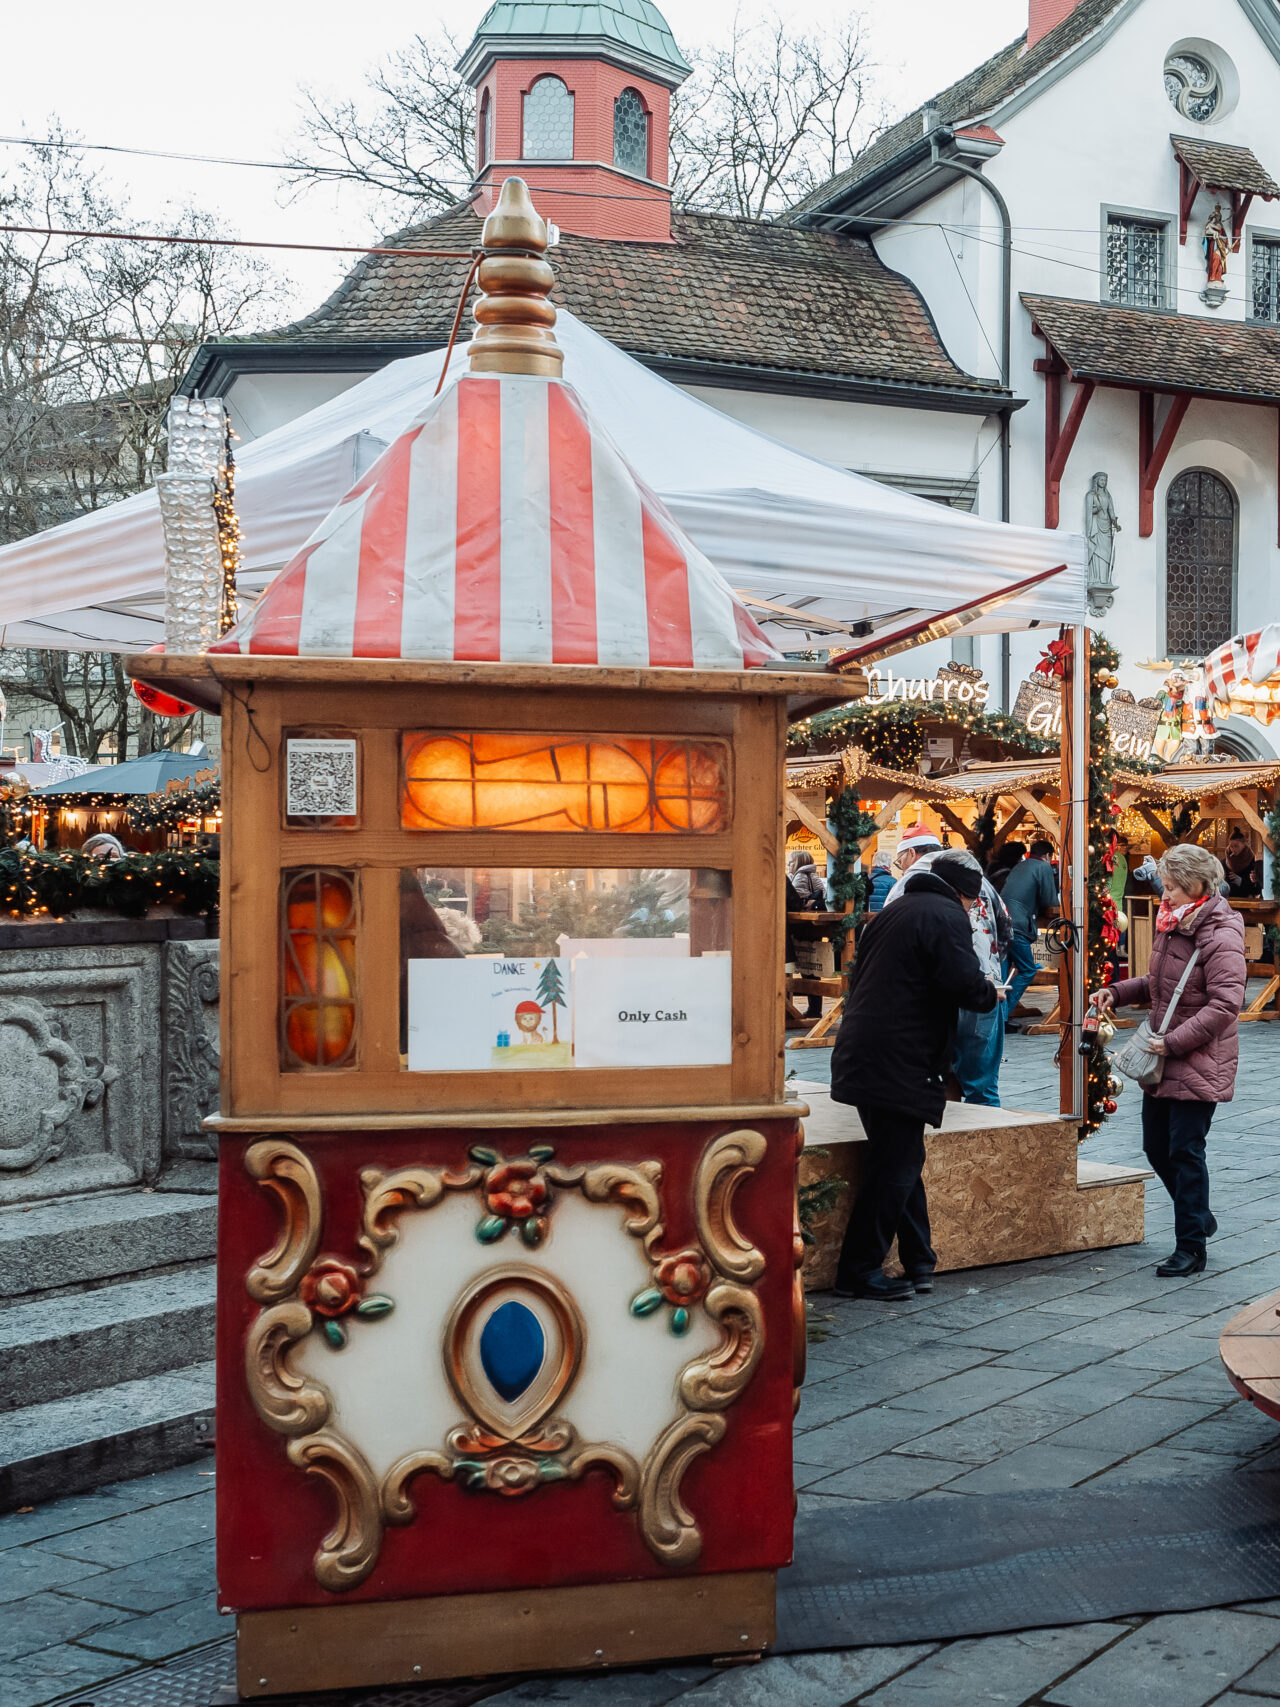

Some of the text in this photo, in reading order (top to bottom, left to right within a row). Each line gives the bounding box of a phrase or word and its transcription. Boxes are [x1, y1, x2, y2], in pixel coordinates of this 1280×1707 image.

[864, 668, 992, 705] Churros
[493, 962, 527, 976] DANKE
[618, 1009, 688, 1024] Only Cash
